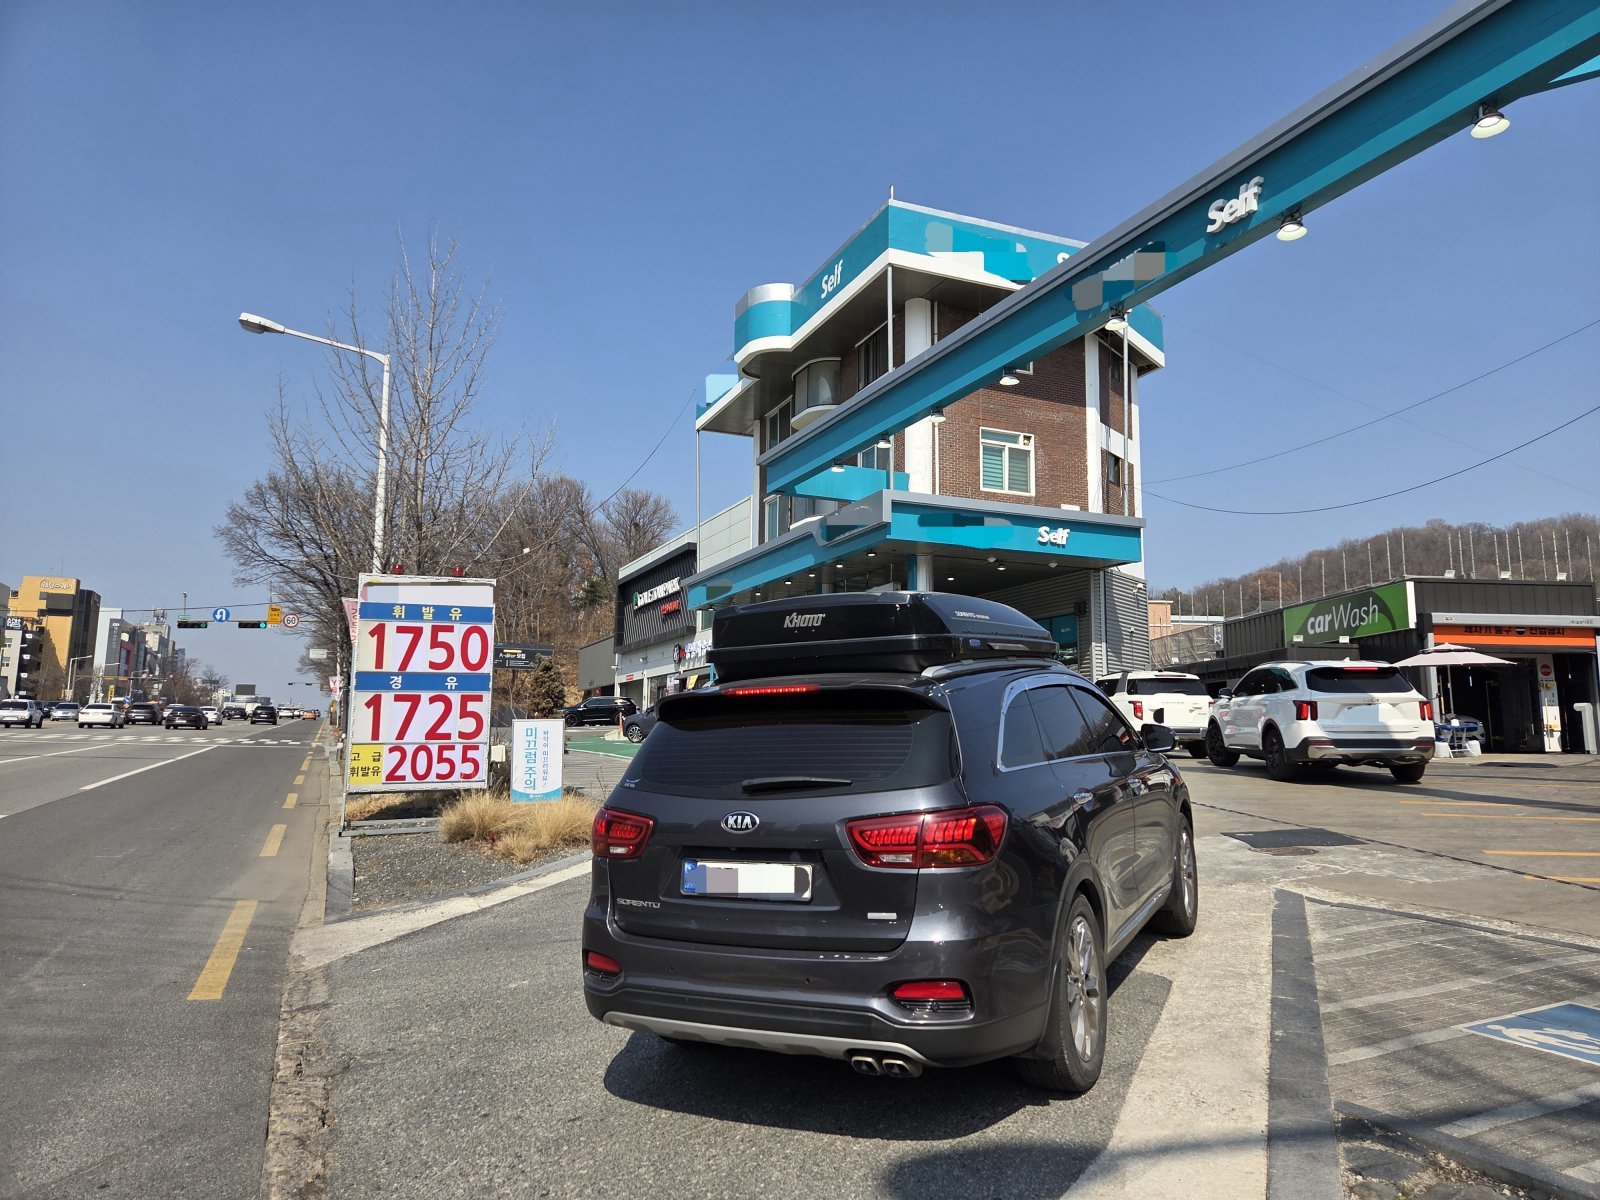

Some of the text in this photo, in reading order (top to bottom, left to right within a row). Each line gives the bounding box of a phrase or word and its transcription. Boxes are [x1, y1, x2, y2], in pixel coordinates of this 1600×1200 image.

[1206, 175, 1264, 233] Self
[820, 258, 844, 299] Self
[1037, 525, 1071, 545] Self
[285, 616, 296, 625] 60
[1307, 597, 1379, 635] carWash
[368, 622, 489, 672] 1750
[364, 693, 484, 741] 1725
[385, 745, 480, 781] 2055
[525, 727, 537, 763] 미끄럼
[350, 765, 382, 778] 휘발유
[524, 766, 537, 790] 주의
[727, 815, 753, 829] KIA
